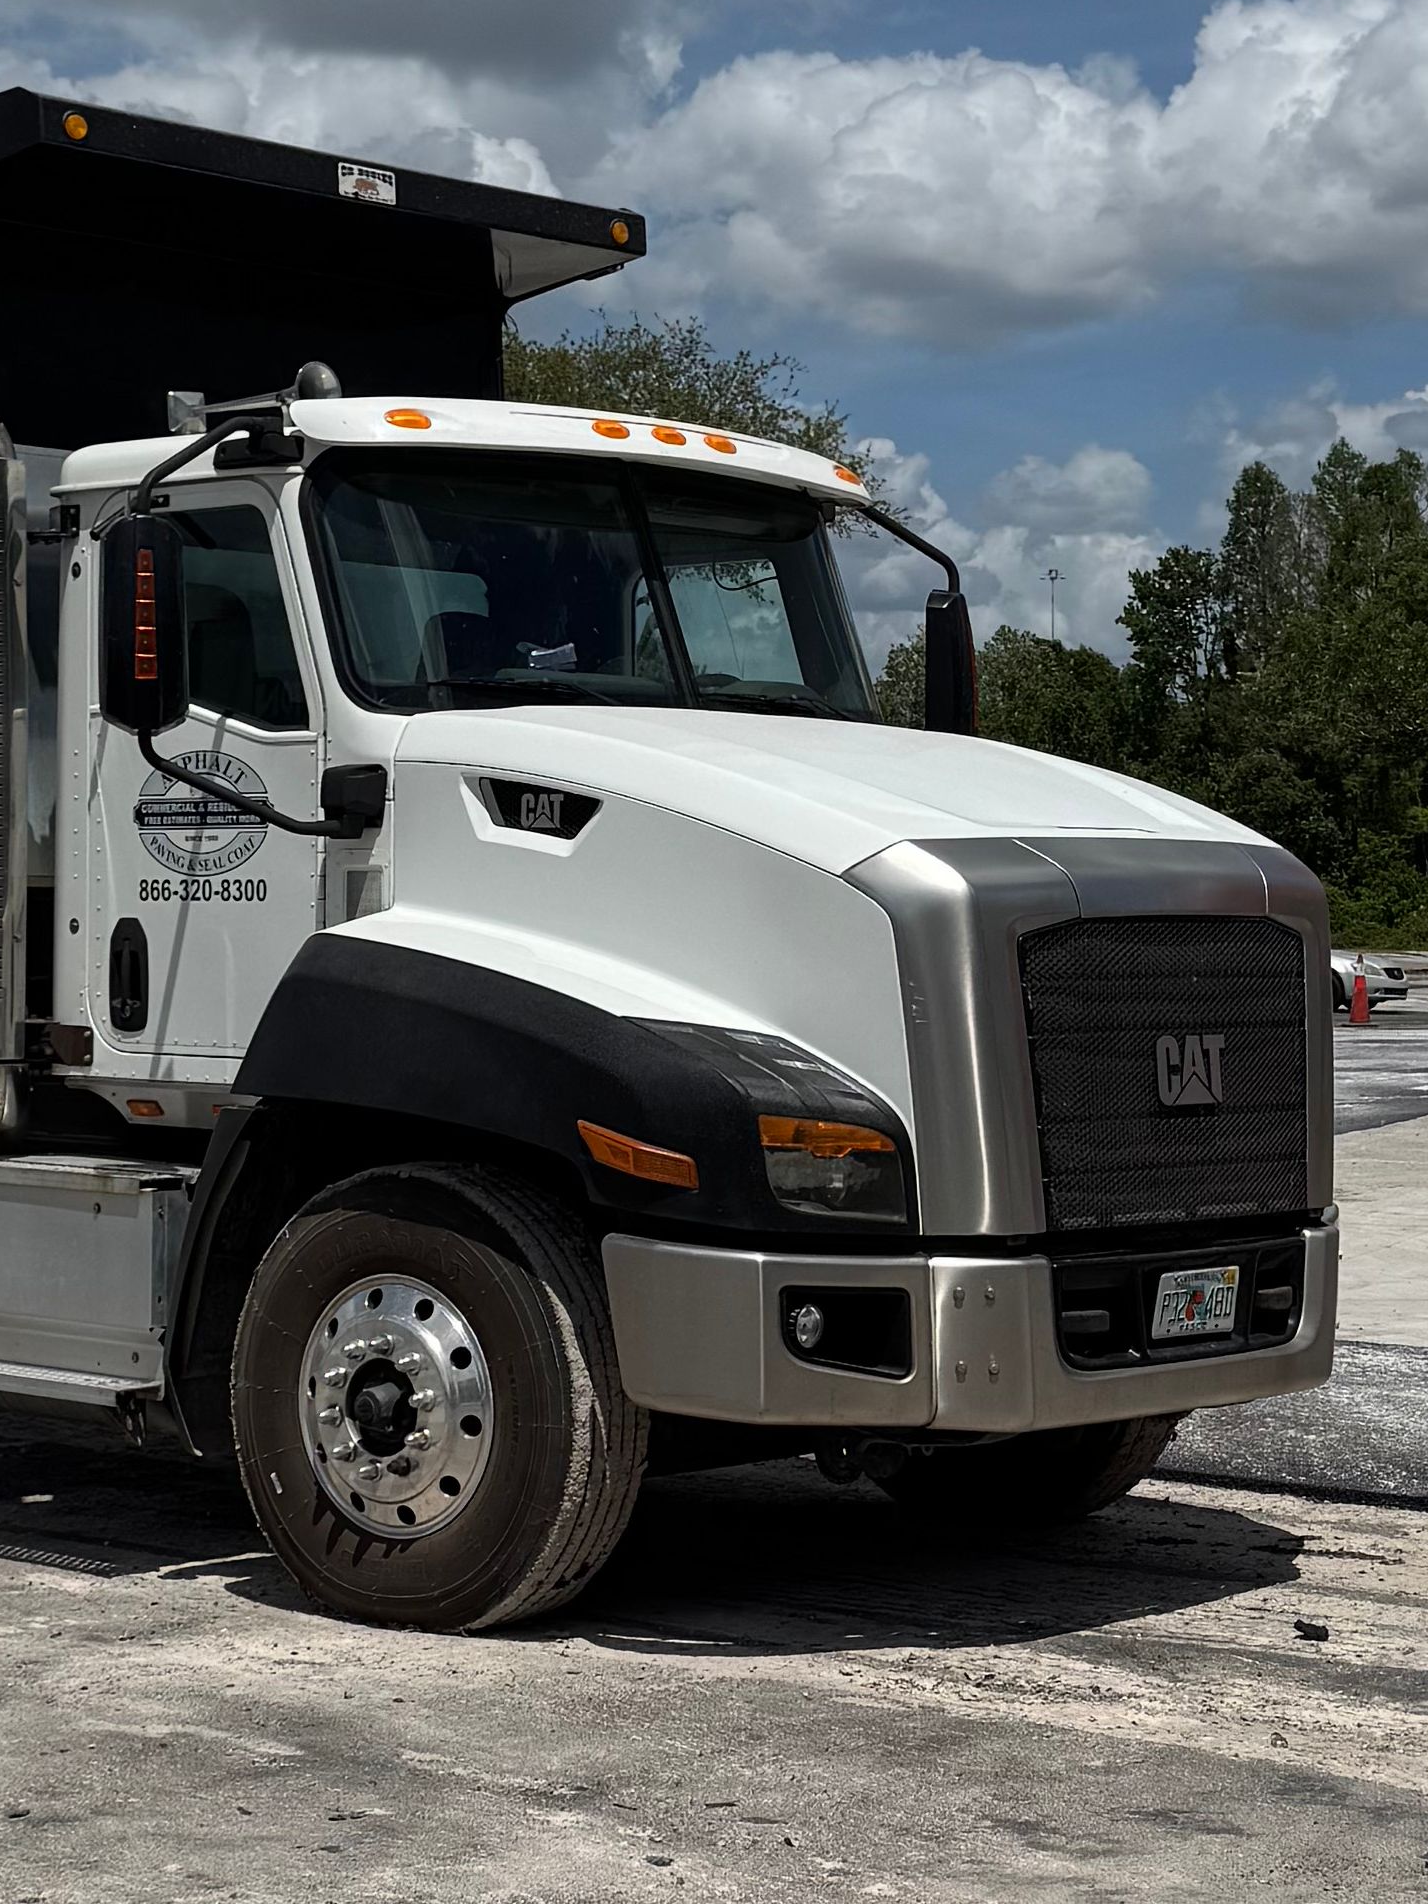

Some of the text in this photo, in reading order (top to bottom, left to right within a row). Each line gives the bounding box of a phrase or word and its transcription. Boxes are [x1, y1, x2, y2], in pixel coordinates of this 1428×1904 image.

[160, 753, 248, 790] APHALT
[520, 793, 565, 829] CAT
[150, 835, 256, 872] PAVING & SEAL COAT
[139, 878, 268, 902] 866-320-8300
[1155, 1034, 1227, 1107] CAT
